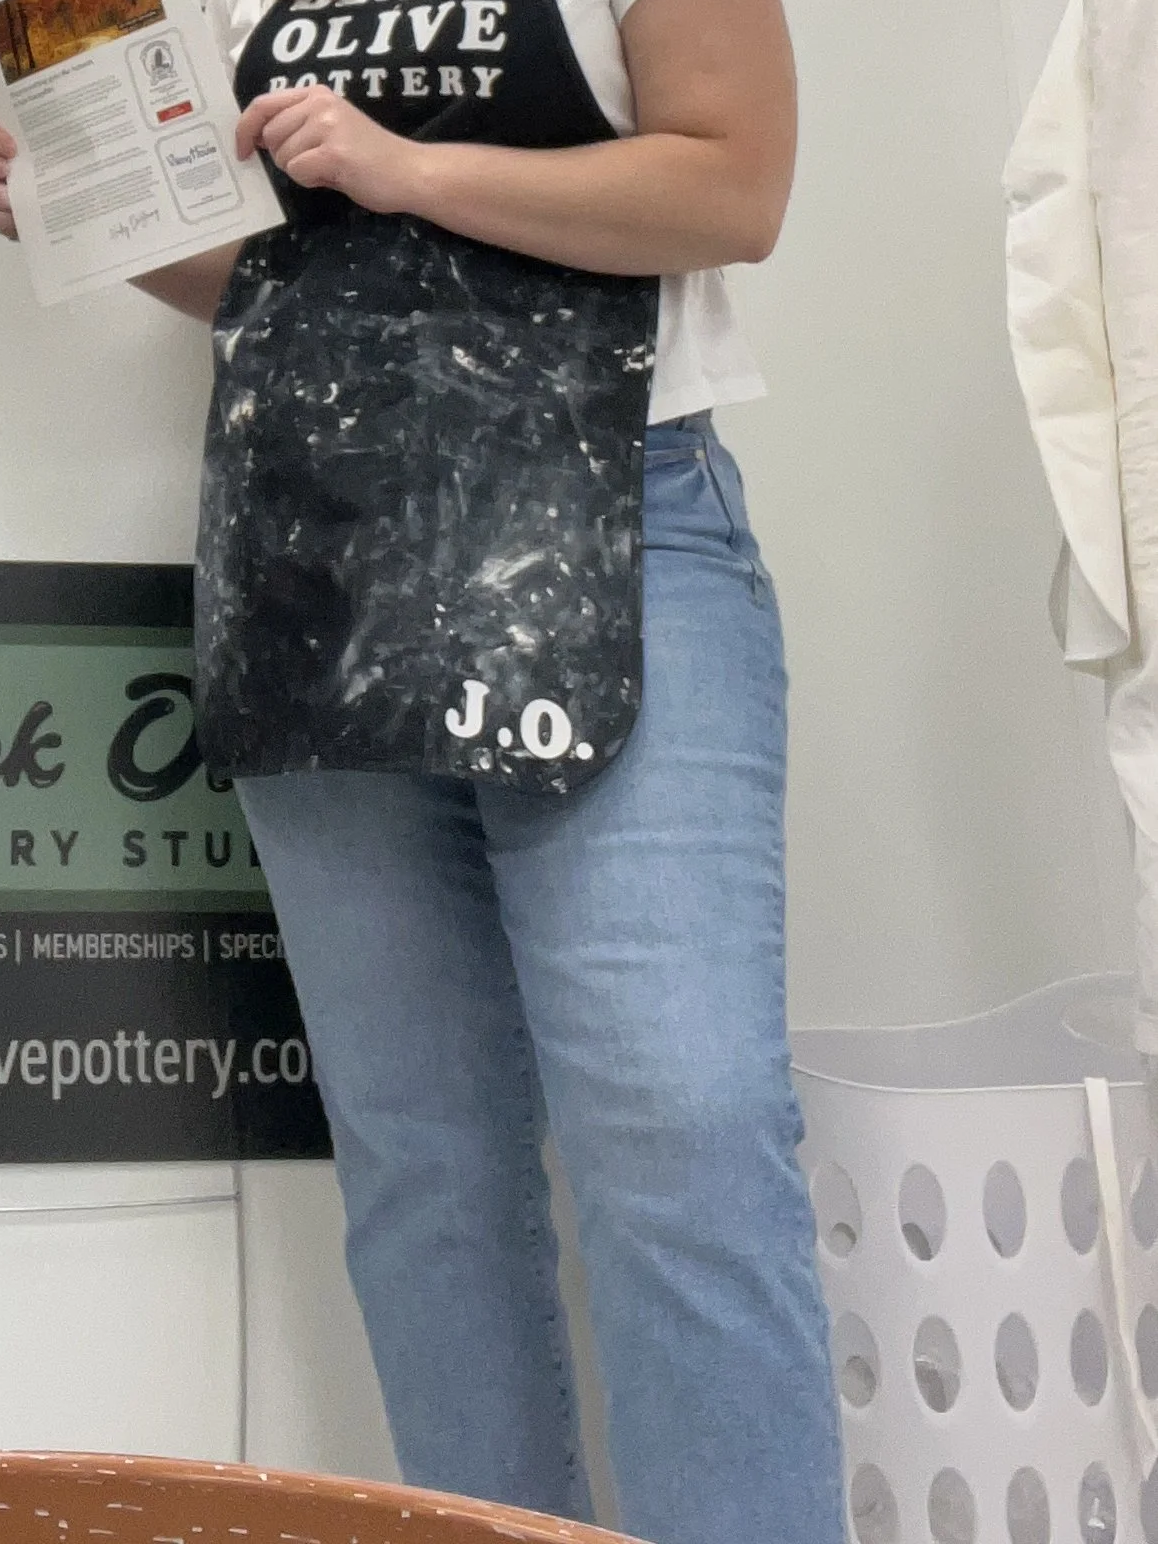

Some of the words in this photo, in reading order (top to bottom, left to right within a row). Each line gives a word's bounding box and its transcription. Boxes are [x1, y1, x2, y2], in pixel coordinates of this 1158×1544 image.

[272, 0, 509, 63] OLIVE
[444, 678, 595, 760] J.O.
[33, 933, 195, 960] MEMBERSHIPS
